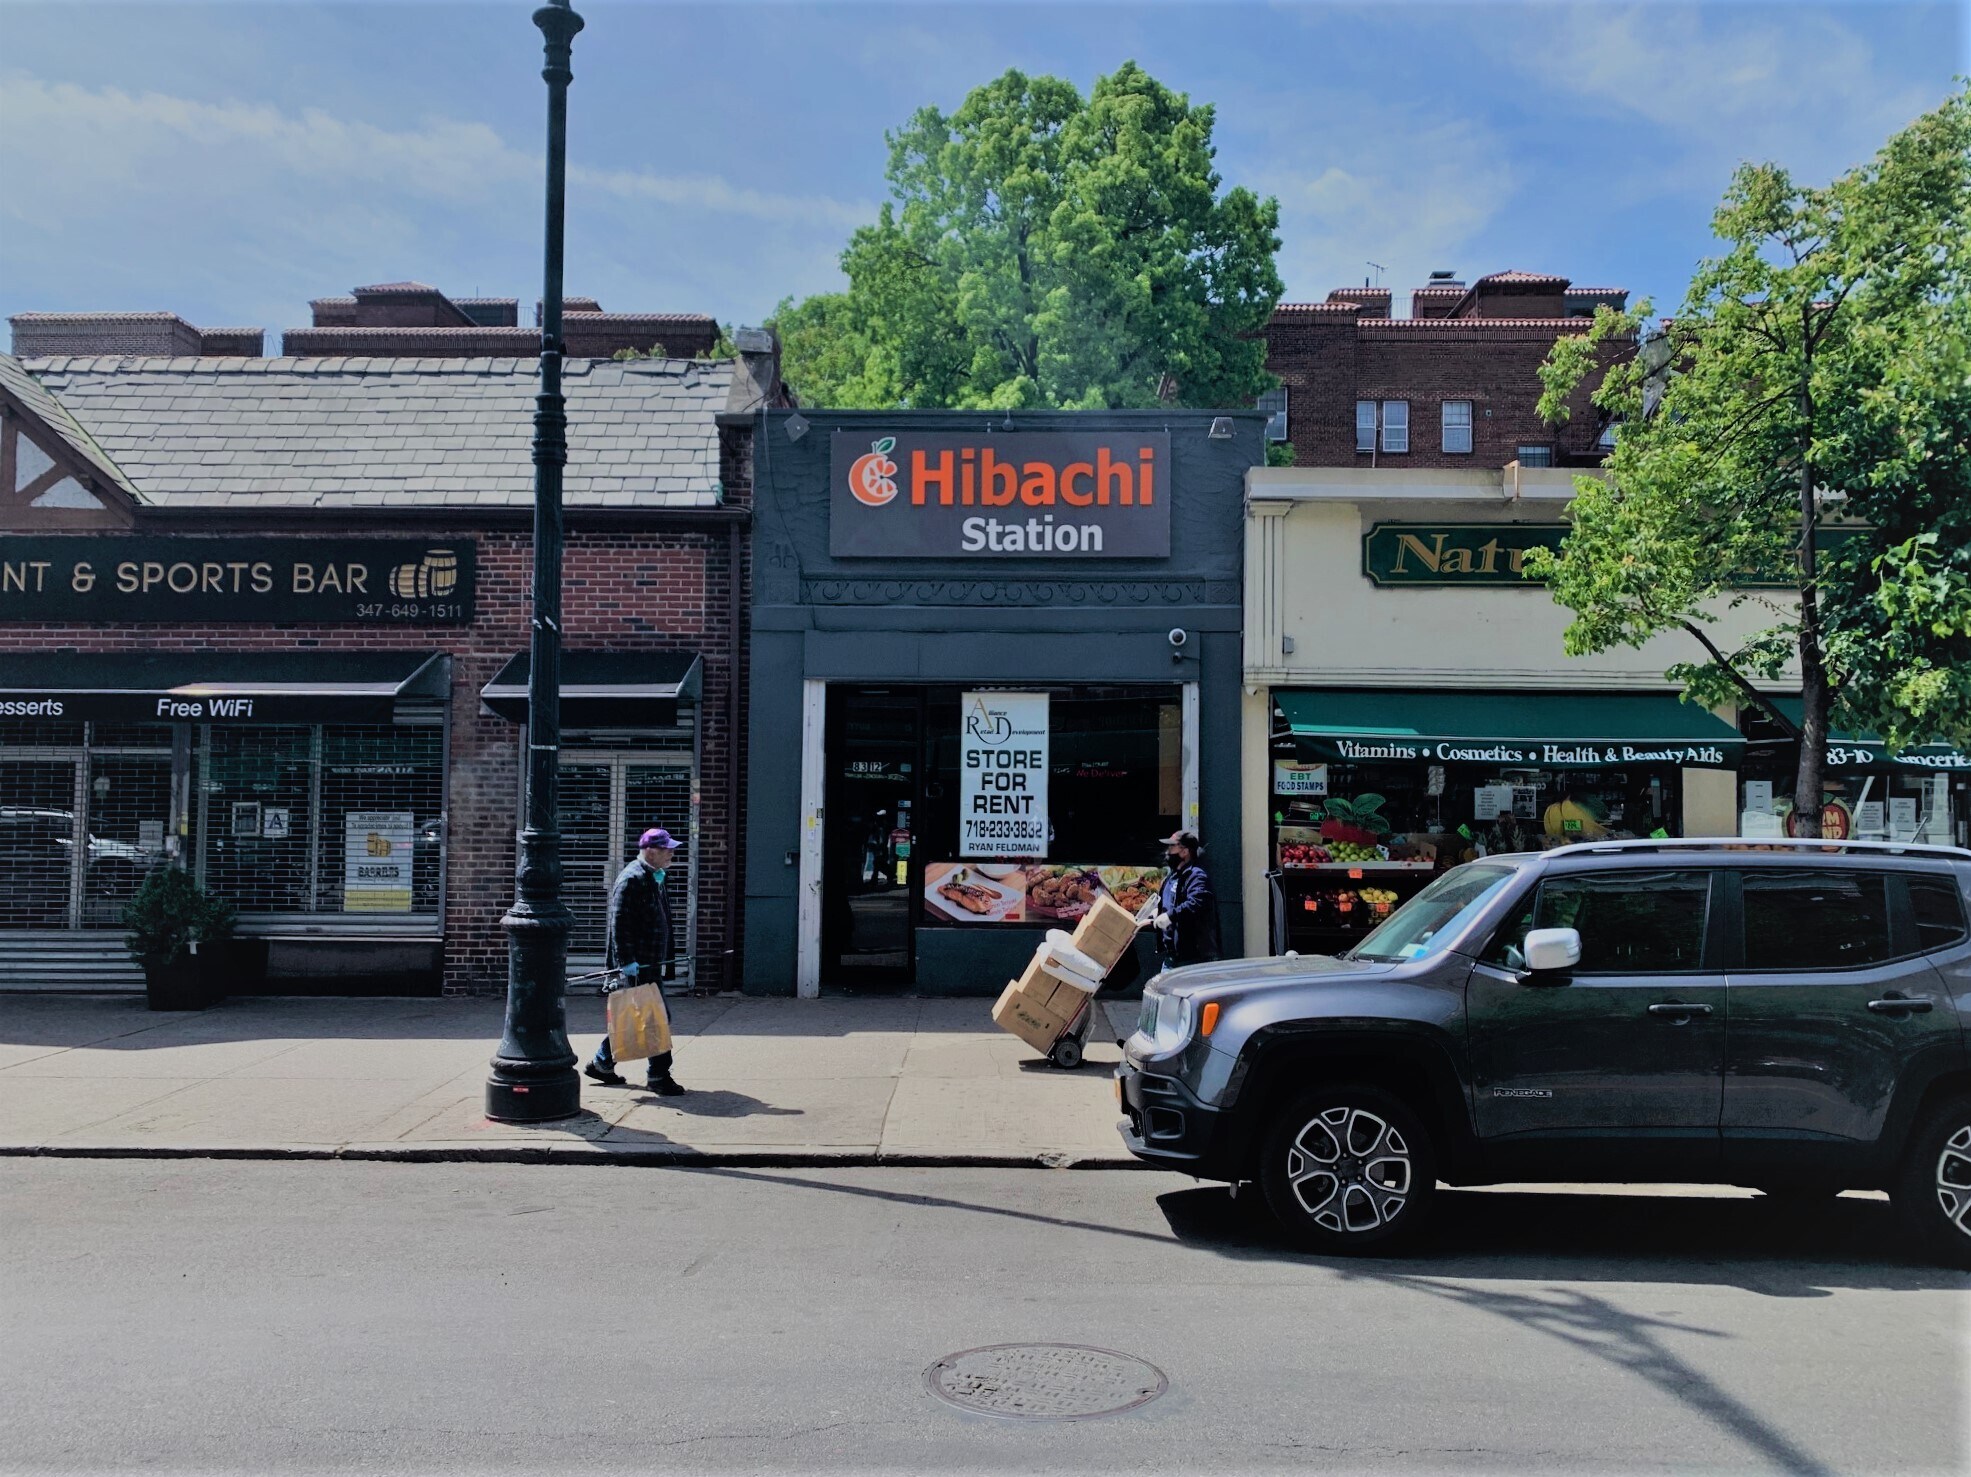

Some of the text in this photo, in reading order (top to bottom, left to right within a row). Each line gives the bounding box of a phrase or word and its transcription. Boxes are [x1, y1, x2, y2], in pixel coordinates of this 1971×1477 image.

[910, 447, 1154, 506] Hibachi
[961, 515, 1103, 552] Station
[3, 562, 368, 594] NT & SPORTS BAR
[156, 698, 254, 718] Free WiFi
[966, 749, 1042, 769] STORE
[1336, 740, 1724, 764] Vitamins Cosmetics Health & Beauty Aids
[982, 772, 1026, 791] FOR
[1277, 781, 1324, 791] FOOD STAMPS
[973, 795, 1034, 814] RENT
[268, 813, 283, 829] A
[968, 843, 1040, 852] RYAN FELDMAN
[1494, 1087, 1552, 1097] RENEGADE
